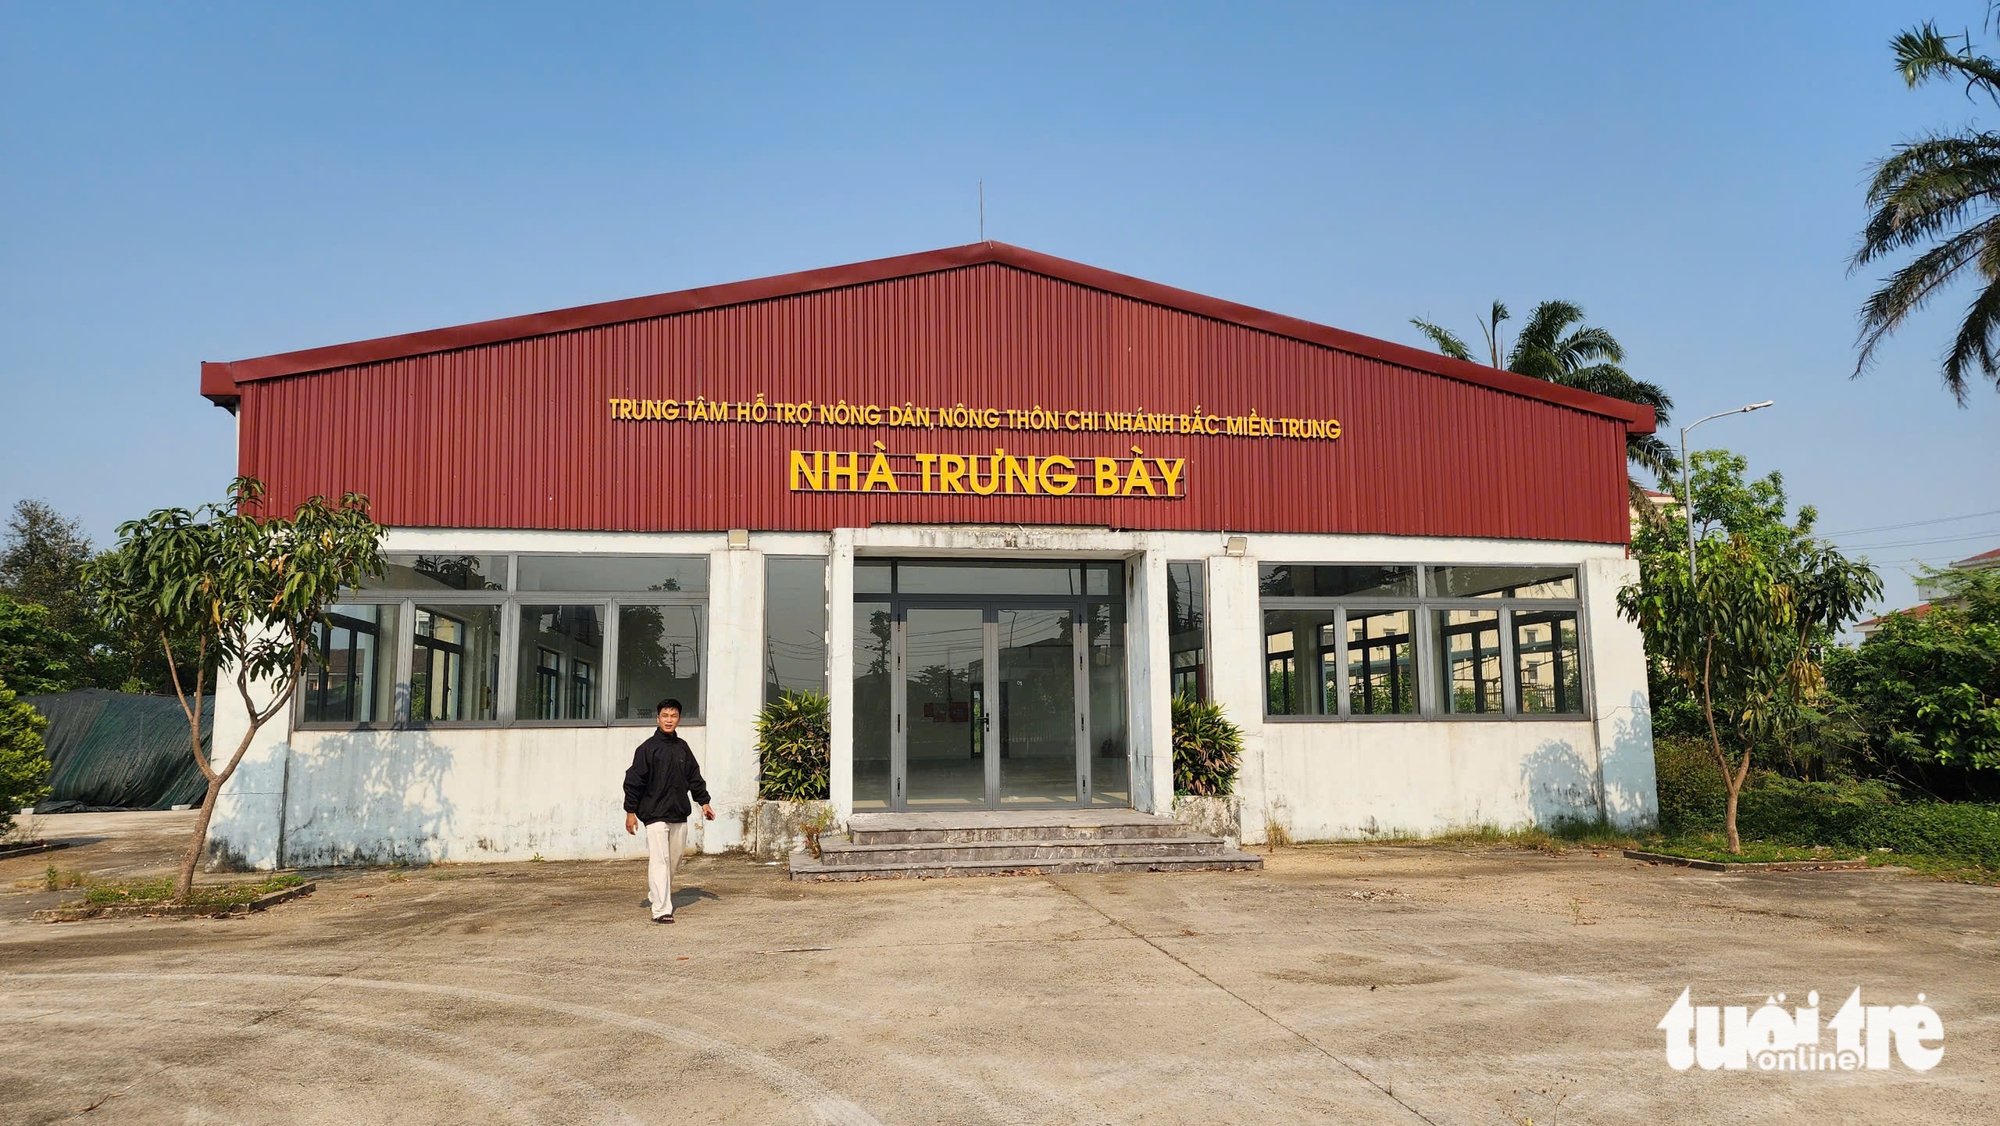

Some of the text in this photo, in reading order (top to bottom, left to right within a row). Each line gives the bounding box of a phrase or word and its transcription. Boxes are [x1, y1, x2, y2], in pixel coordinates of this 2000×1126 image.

[609, 392, 1342, 439] TRUNG TÂM HỖ TRỢ NÔNG DÂN, NÔNG THÔN CHI NHÁNH BẮC MIỀN TRUNG
[790, 440, 1185, 497] NHÀ TRƯNG BÀY
